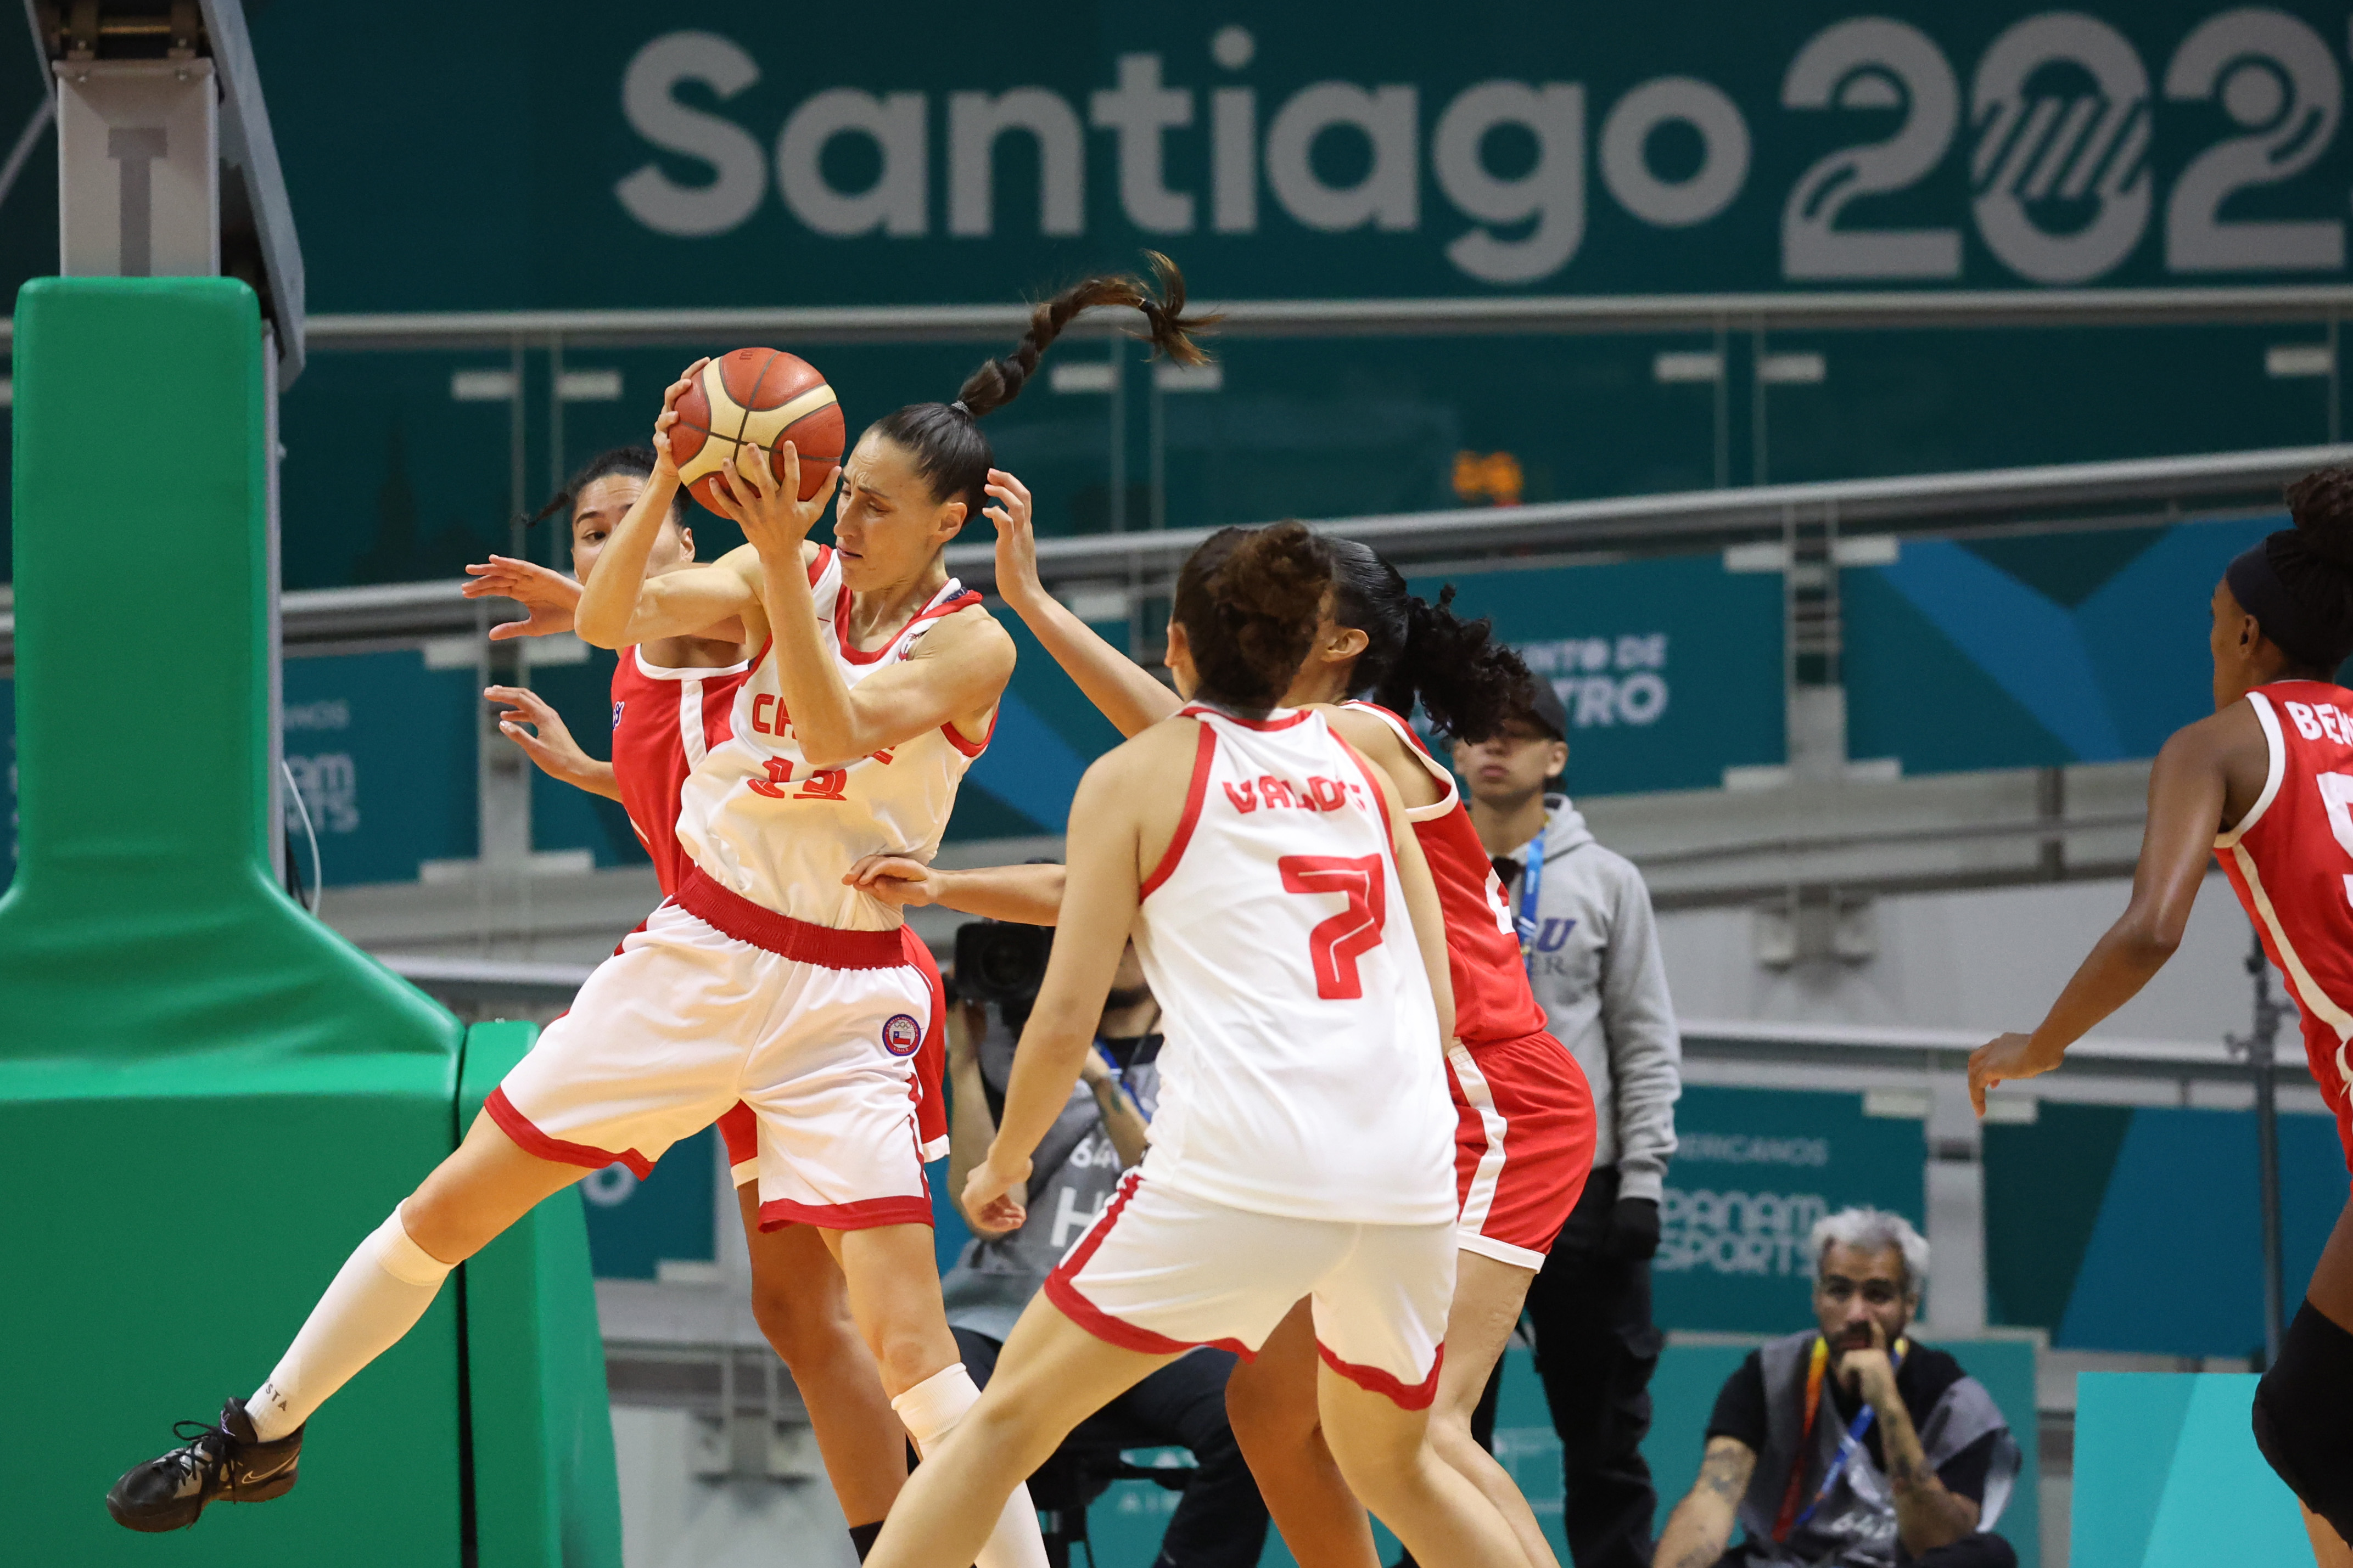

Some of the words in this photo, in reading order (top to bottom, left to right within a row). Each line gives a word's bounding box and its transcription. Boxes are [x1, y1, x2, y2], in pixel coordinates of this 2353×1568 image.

[614, 26, 1751, 283] Santiago
[1780, 7, 2353, 284] 202
[1278, 853, 1386, 999] 7
